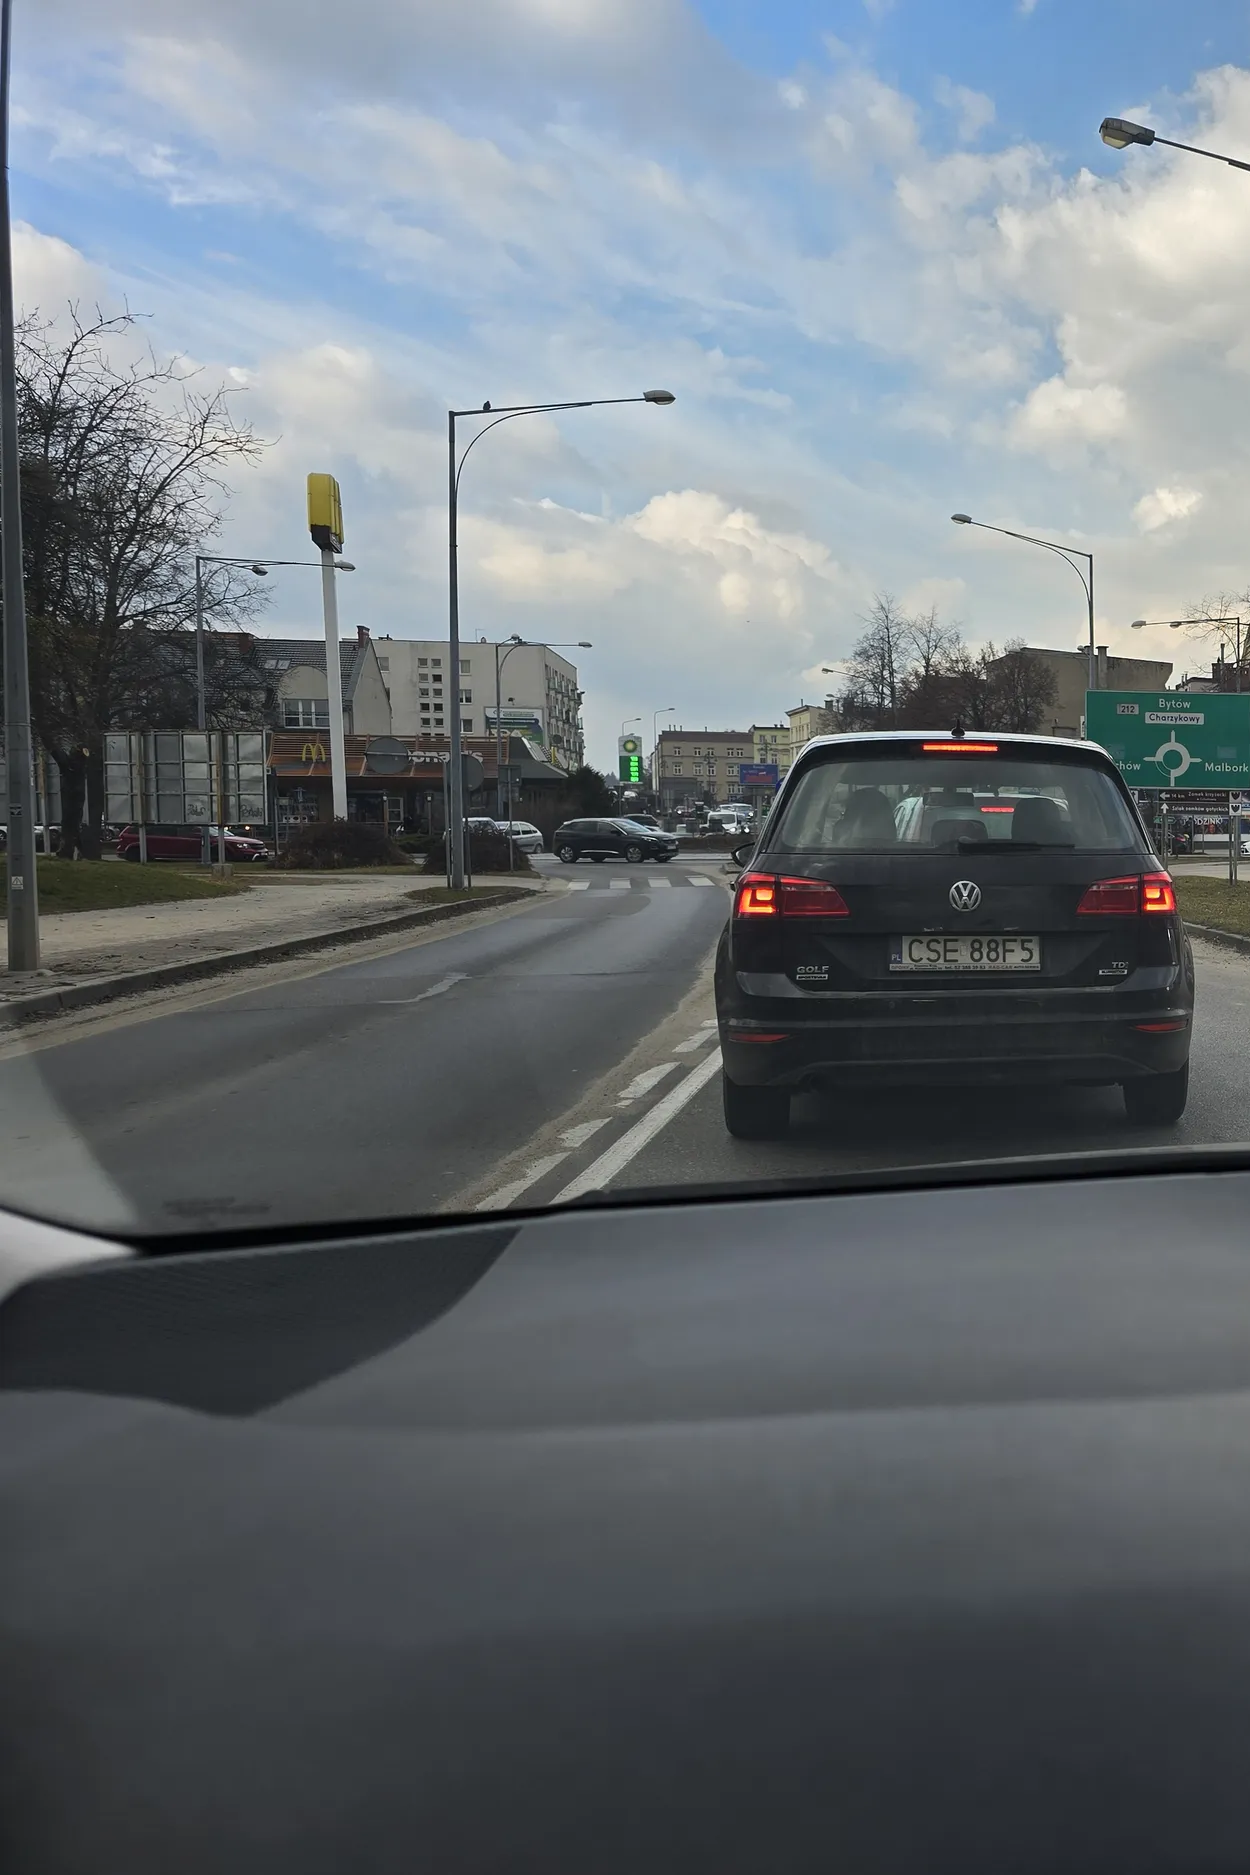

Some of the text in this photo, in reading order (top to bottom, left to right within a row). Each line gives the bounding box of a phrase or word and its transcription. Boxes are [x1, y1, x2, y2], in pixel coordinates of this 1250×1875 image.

[1121, 705, 1135, 714] 212
[1158, 698, 1191, 710] Bytów
[1149, 713, 1200, 724] Charzykowy
[1204, 762, 1249, 773] Malbork
[908, 938, 1034, 963] CSE 88F5
[796, 965, 830, 974] GOLF
